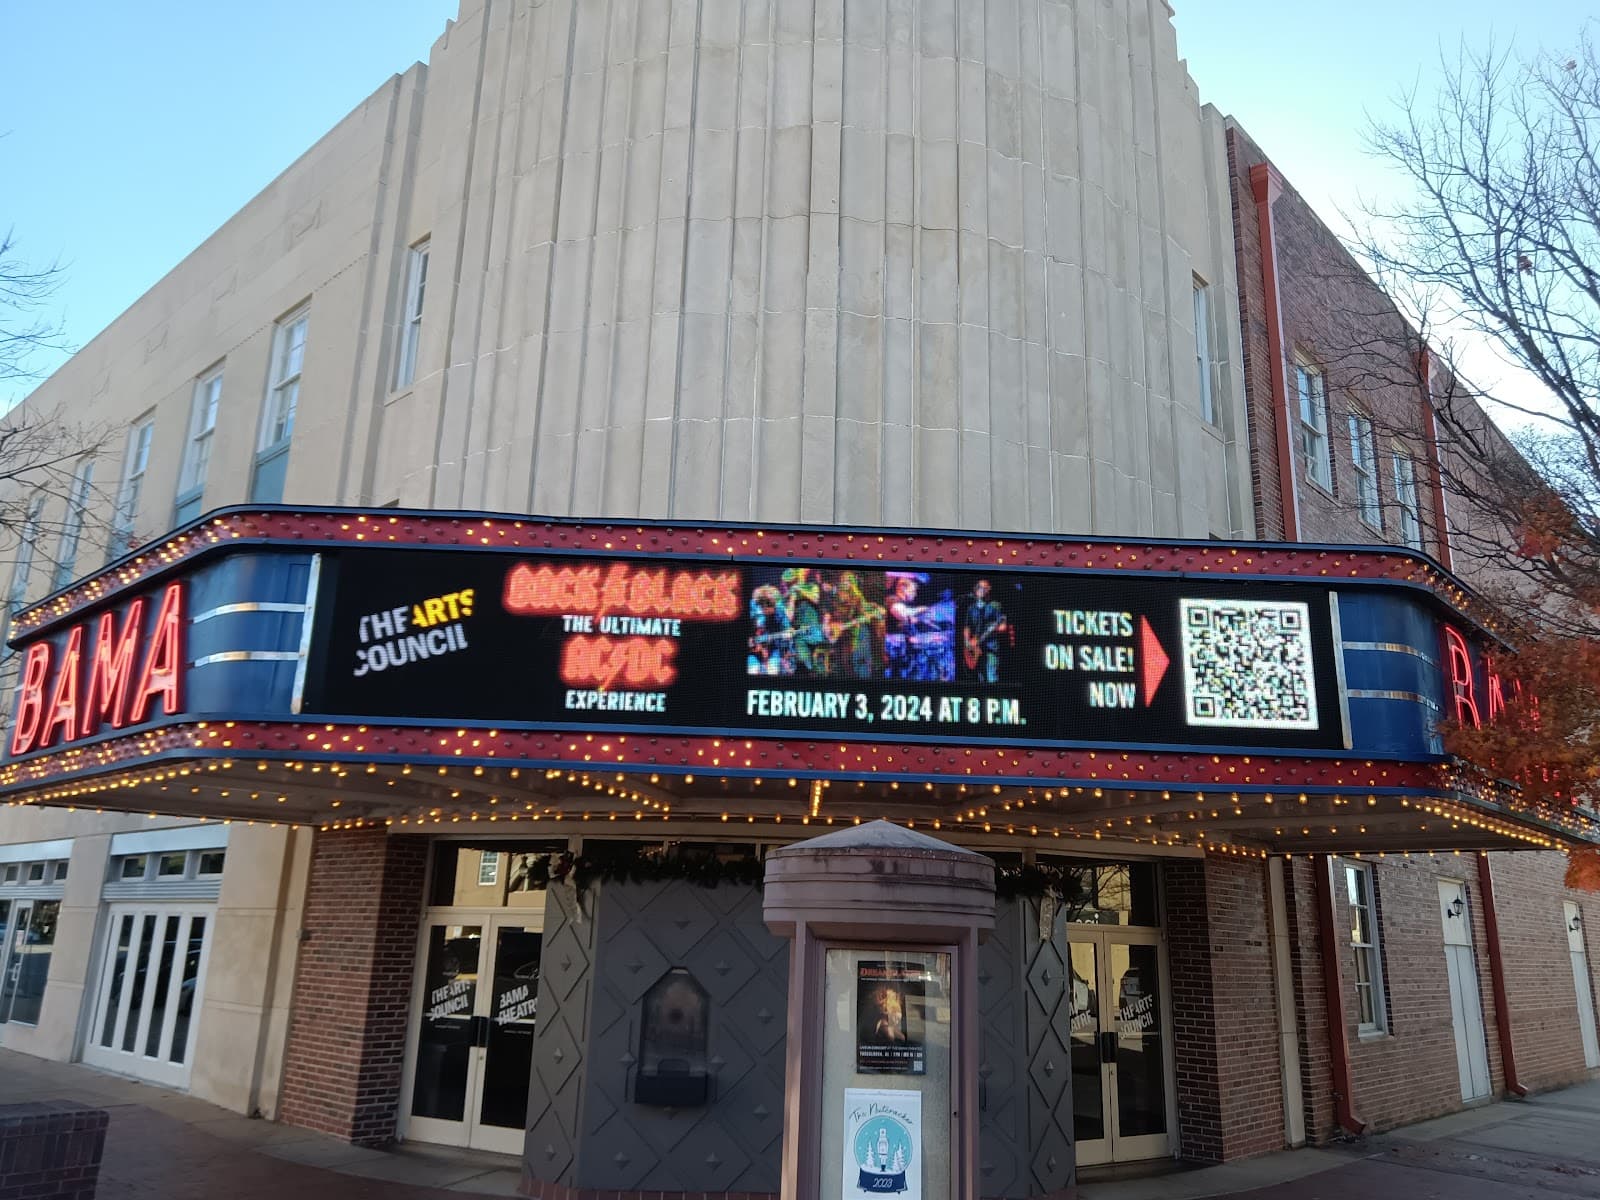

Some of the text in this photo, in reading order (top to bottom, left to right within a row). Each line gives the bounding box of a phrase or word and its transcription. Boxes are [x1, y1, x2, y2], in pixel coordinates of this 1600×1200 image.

[411, 588, 474, 628] ARTS
[562, 615, 681, 636] THE ULTIMATE
[1053, 609, 1133, 636] TICKETS
[353, 622, 468, 676] COUNCIL
[563, 635, 674, 684] AC/DC
[1045, 644, 1135, 672] ON SALE!
[11, 579, 182, 756] BAMA
[565, 690, 666, 713] EXPERIENCE
[747, 689, 1027, 725] FEBRUARY 3, 2024 AT 8 P.M.
[1088, 682, 1136, 708] NOW
[500, 985, 529, 1009] BAMA
[499, 998, 538, 1026] THEATR
[872, 1178, 893, 1188] 2023
